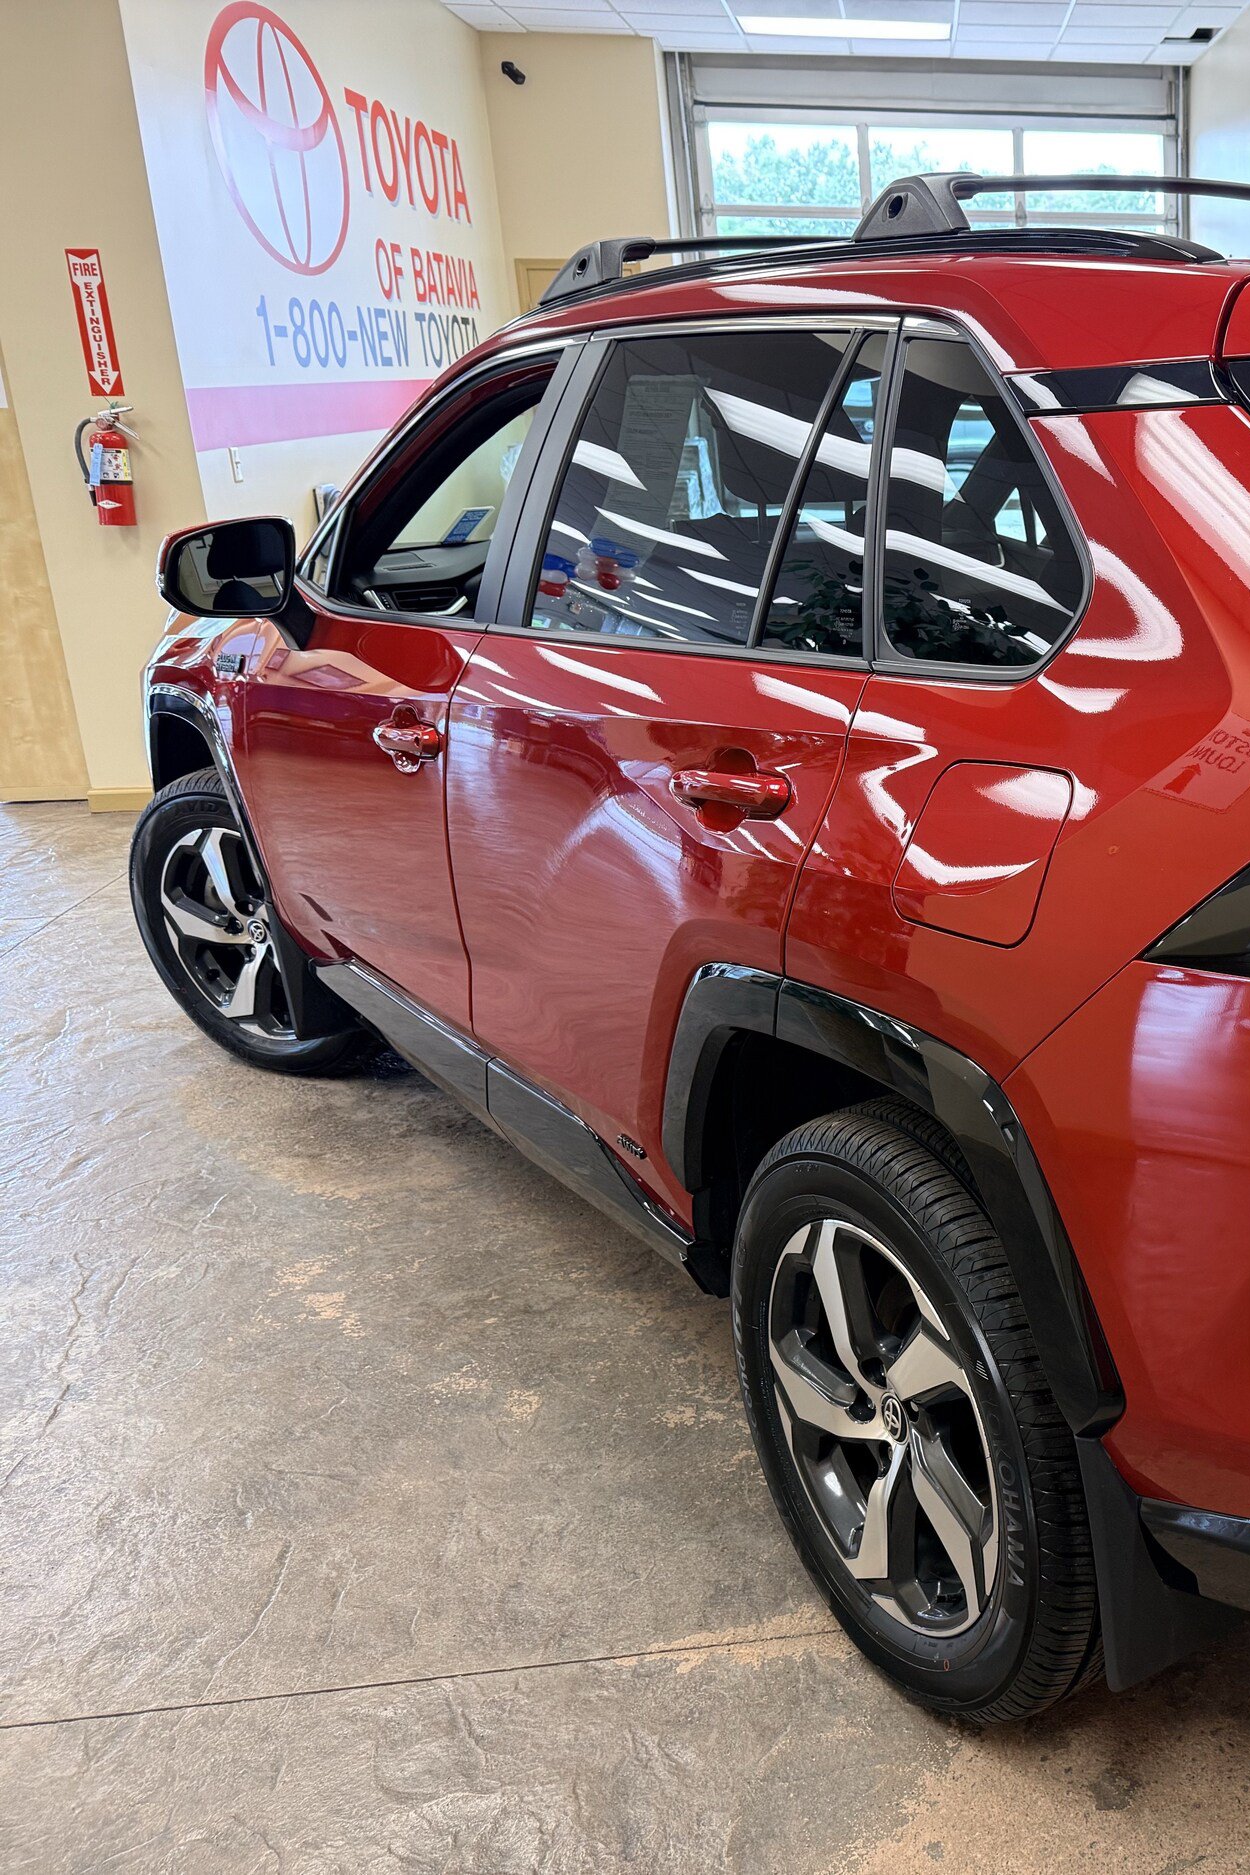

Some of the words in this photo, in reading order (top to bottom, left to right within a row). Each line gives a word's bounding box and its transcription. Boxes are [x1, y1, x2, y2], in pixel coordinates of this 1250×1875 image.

[343, 87, 472, 225] TOYOTA
[72, 262, 98, 277] FIRE
[374, 237, 403, 301] OF
[410, 247, 481, 310] BATAVIA
[83, 281, 111, 386] EXTINGUISHER
[256, 294, 409, 368] 1-800-NEW
[981, 1392, 1025, 1588] YOKOHAMA
